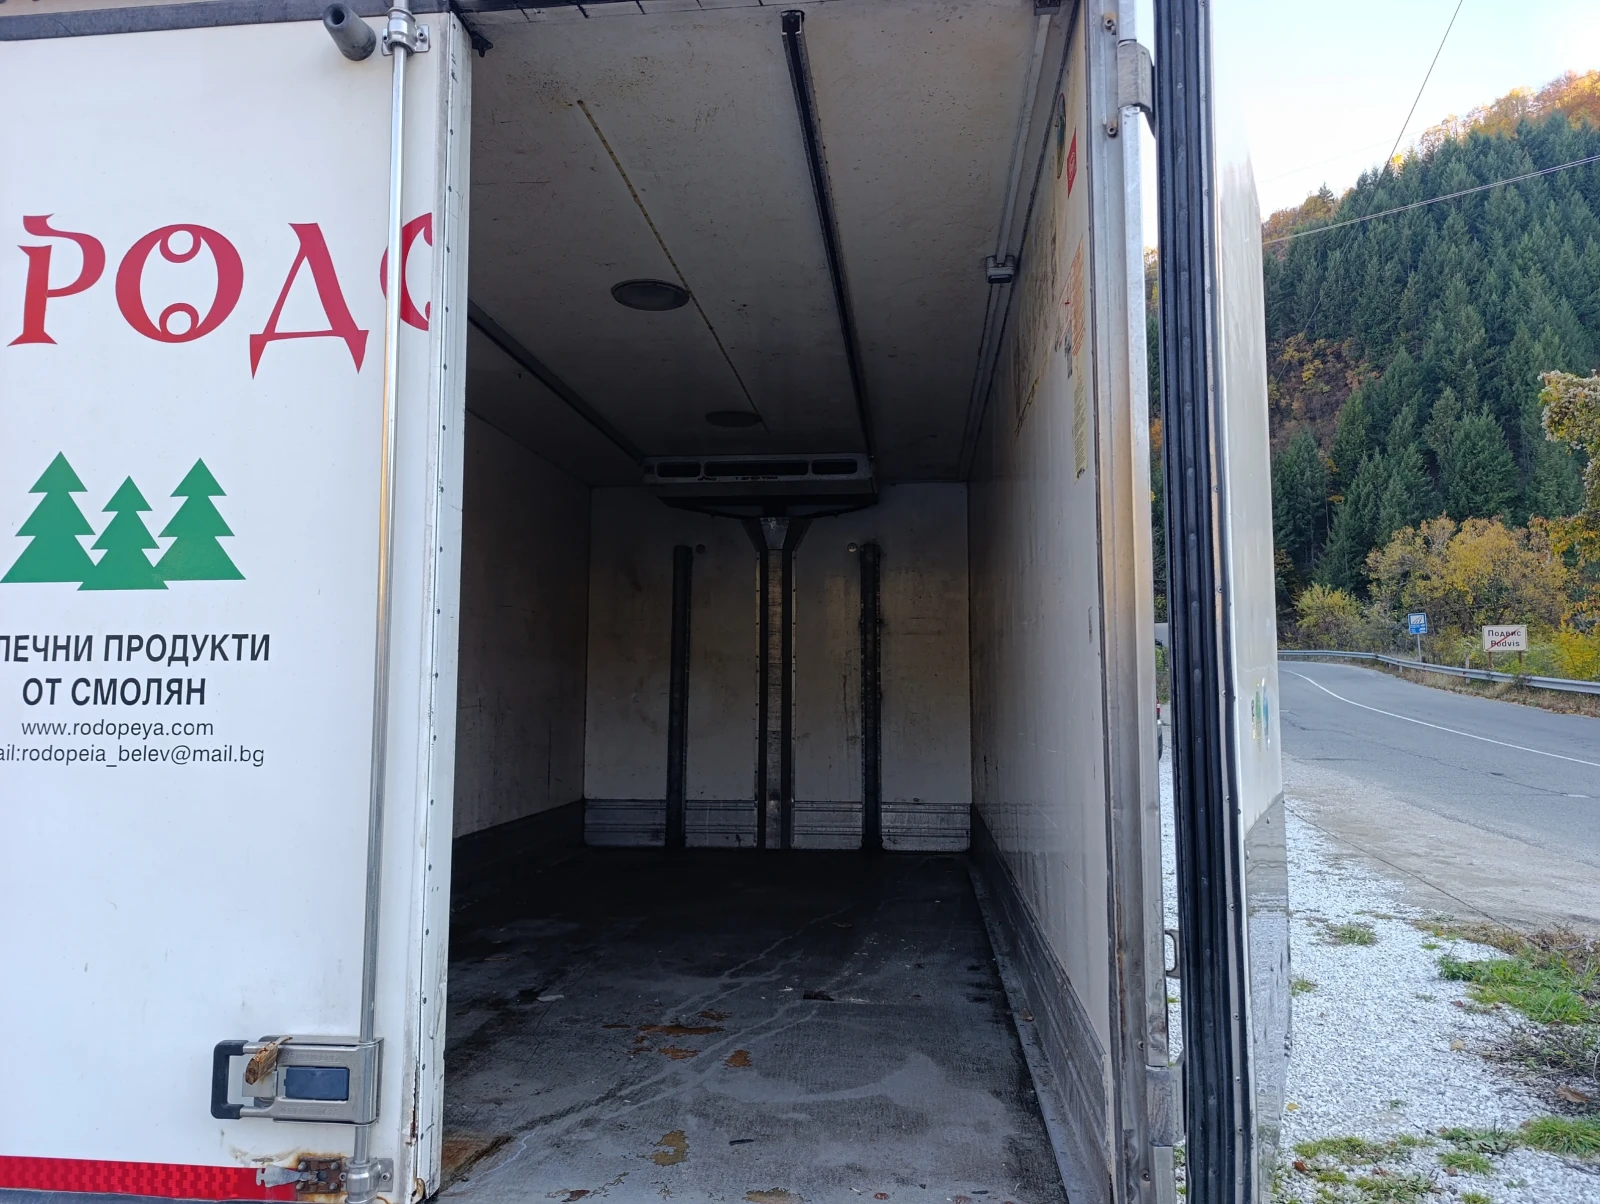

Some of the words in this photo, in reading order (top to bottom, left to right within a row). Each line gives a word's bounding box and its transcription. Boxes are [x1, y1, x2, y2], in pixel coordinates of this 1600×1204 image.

[1487, 629, 1522, 637] Подвис
[103, 633, 270, 668] ПРОДУКТИ
[22, 677, 62, 706] ОТ
[71, 677, 206, 706] СМОЛЯН
[21, 719, 214, 740] www.rodopeya.com
